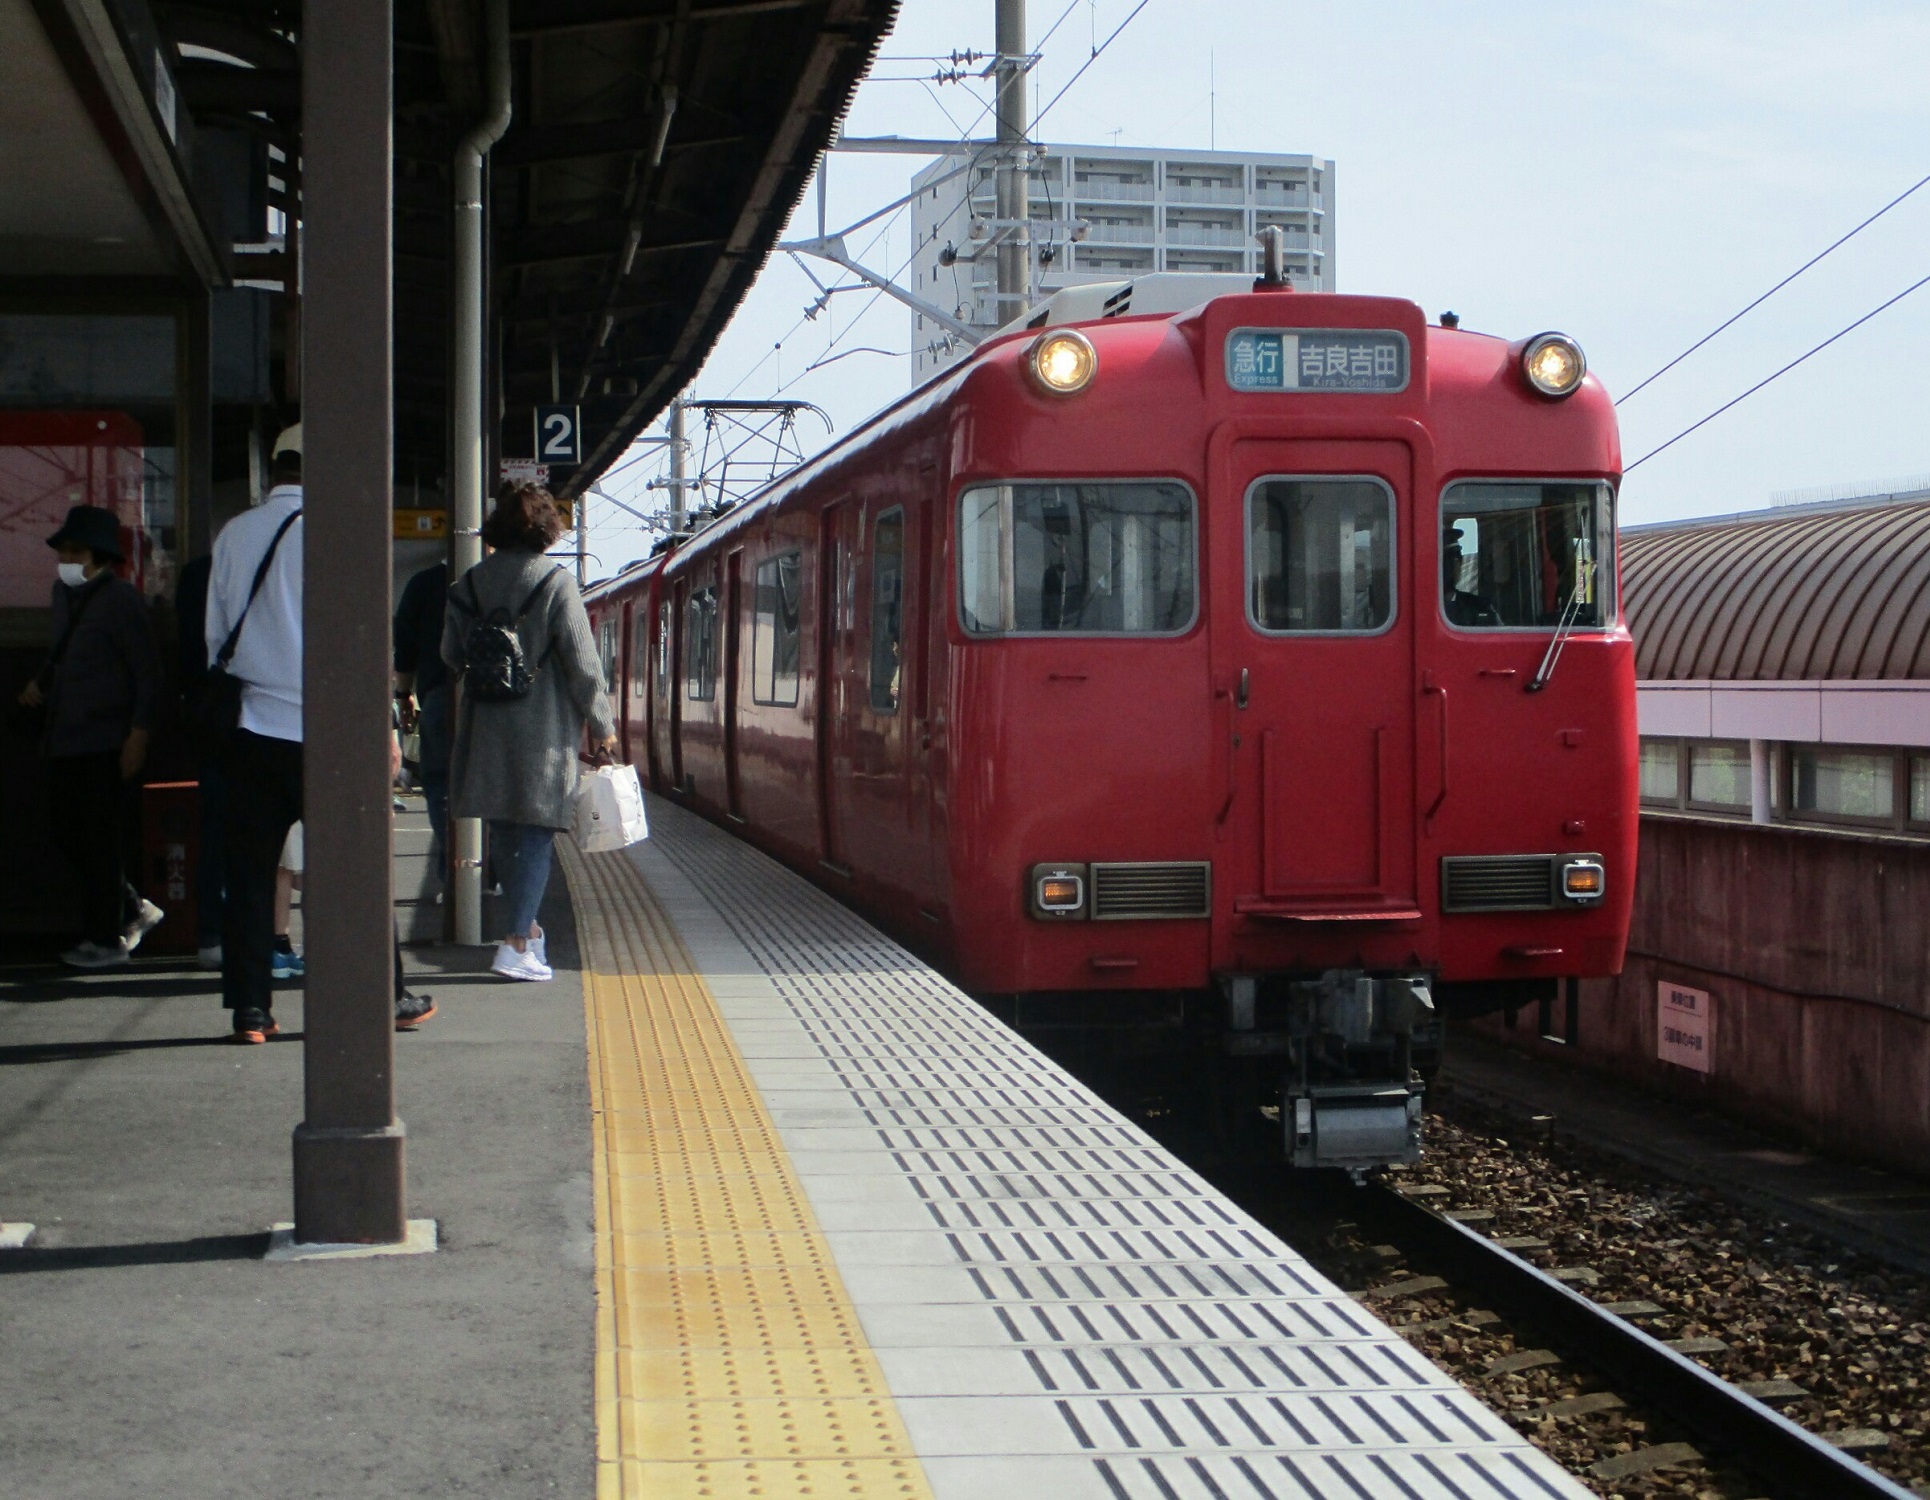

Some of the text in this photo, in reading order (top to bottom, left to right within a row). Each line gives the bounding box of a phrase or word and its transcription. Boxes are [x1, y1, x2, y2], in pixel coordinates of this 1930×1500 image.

[1234, 341, 1279, 373] 急行
[1301, 345, 1397, 376] 吉良吉田
[1234, 374, 1278, 386] Express
[1313, 377, 1387, 388] Kira-Yoshida
[544, 413, 572, 455] 2
